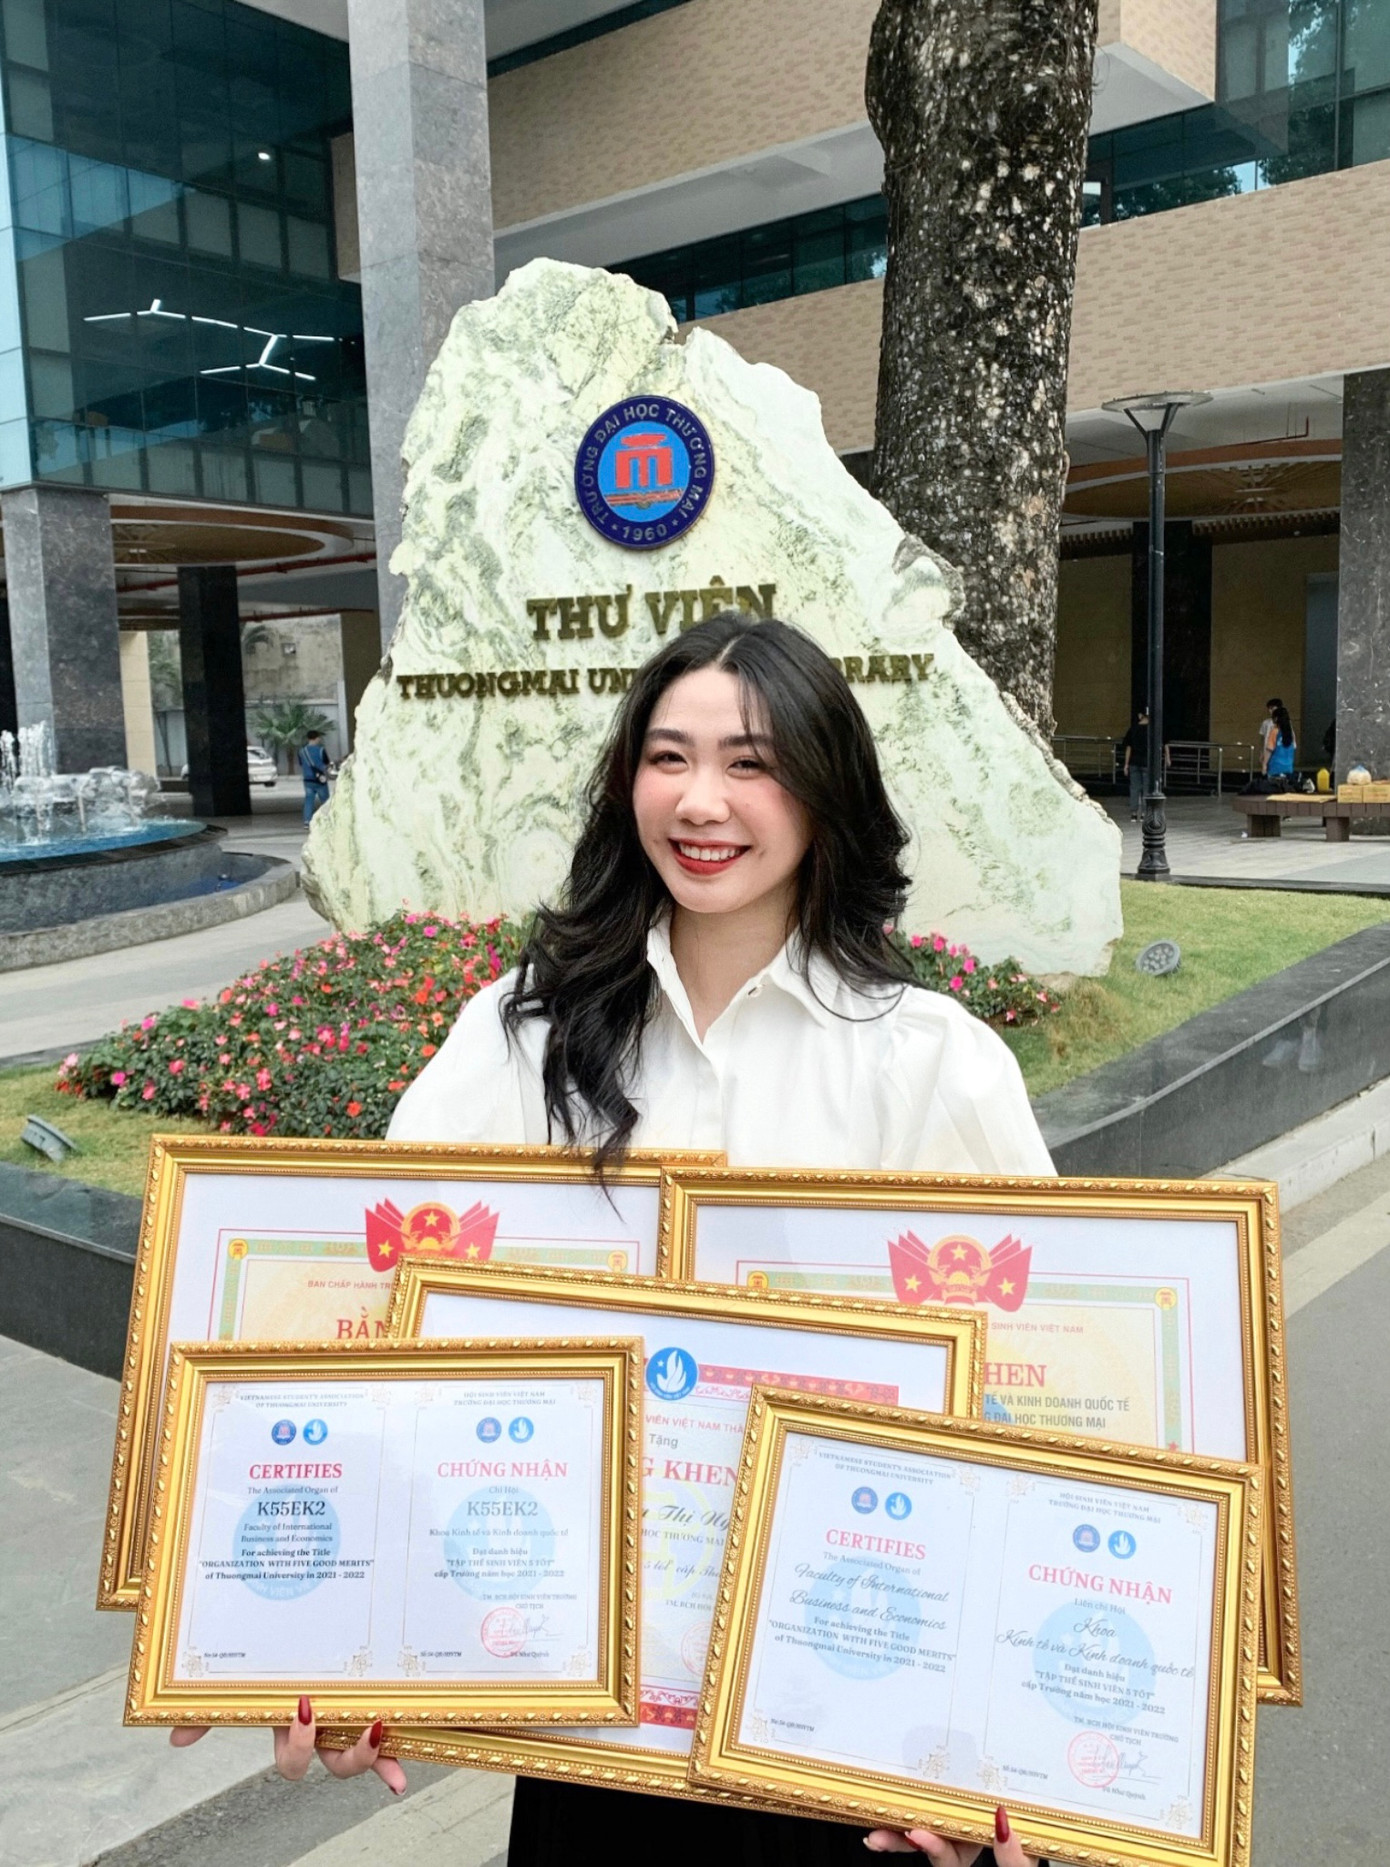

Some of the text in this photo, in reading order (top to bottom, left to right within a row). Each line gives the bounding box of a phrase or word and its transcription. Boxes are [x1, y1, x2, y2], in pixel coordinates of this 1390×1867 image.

[623, 404, 660, 420] HỌC
[594, 414, 621, 443] ĐẠI
[666, 408, 707, 479] THƯƠNG
[679, 484, 704, 519] MẠI
[622, 524, 668, 541] 1960
[526, 583, 633, 641] THƯ
[396, 668, 581, 700] THUONGMAI
[827, 653, 935, 683] RARY
[307, 1280, 326, 1288] BAN
[328, 1279, 352, 1288] CHẤP
[353, 1280, 377, 1289] HÀNH
[337, 1306, 387, 1339] BẰN
[991, 1322, 1084, 1334] SINH VIÊN VIỆT NAM
[984, 1362, 1047, 1387] HEN
[1000, 1392, 1014, 1406] VÀ
[1017, 1395, 1042, 1407] KINH
[1045, 1397, 1082, 1410] DOANH
[1085, 1395, 1115, 1411] QUỐC
[1117, 1396, 1130, 1412] TẾ
[645, 1414, 721, 1431] VIÊN VIỆT NAM
[1086, 1416, 1106, 1431] MẠI
[648, 1433, 679, 1449] Tặng
[249, 1463, 343, 1480] CERTIFIES
[438, 1459, 568, 1481] CHỨNG NHẬN
[890, 1472, 934, 1485] UNIVERSITY
[248, 1486, 339, 1496] The Associated Organ of
[488, 1486, 519, 1494] Chi Hội
[257, 1500, 326, 1516] K55EK2
[467, 1501, 538, 1517] K55EK2
[244, 1522, 332, 1533] Faculty of International
[429, 1528, 450, 1537] Khoa
[452, 1528, 470, 1536] Kinh
[482, 1528, 492, 1536] và
[492, 1528, 512, 1536] Kinh
[514, 1528, 538, 1536] doanh
[241, 1534, 333, 1543] Business and Economics
[826, 1528, 927, 1560] CERTIFIES
[241, 1548, 332, 1558] For achieving the Title
[472, 1548, 528, 1556] Đạt danh hiệu
[268, 1560, 291, 1568] WITH
[292, 1560, 312, 1568] FIVE
[312, 1559, 338, 1568] GOOD
[486, 1559, 506, 1567] SINH
[507, 1558, 528, 1567] VIÊN
[823, 1551, 921, 1576] The Associated Organ of
[205, 1570, 365, 1582] of Thuongmai University in 2021 2022
[434, 1570, 565, 1580] cấp Trường năm học 2021 2022
[846, 1574, 860, 1589] of
[860, 1574, 950, 1602] International
[1028, 1564, 1173, 1605] CHỨNG NHẬN
[790, 1589, 947, 1630] Business and Economics
[1074, 1598, 1094, 1609] Liên
[1110, 1604, 1126, 1616] Hội
[814, 1616, 910, 1642] For achieving the Title
[1073, 1617, 1117, 1638] Khoa
[842, 1634, 868, 1646] WITH
[868, 1638, 890, 1650] FIVE
[890, 1642, 917, 1654] GOOD
[996, 1628, 1034, 1648] Kinh
[1050, 1641, 1068, 1654] và
[1068, 1642, 1108, 1663] Kinh
[1109, 1653, 1149, 1670] doanh
[774, 1634, 946, 1673] of Thuongmai University in 2021 2022
[1064, 1663, 1126, 1683] Đạt danh hiệu
[1078, 1678, 1102, 1690] SINH
[1103, 1682, 1125, 1695] VIÊN
[1020, 1679, 1166, 1715] cấp Trường năm học 2021 2022
